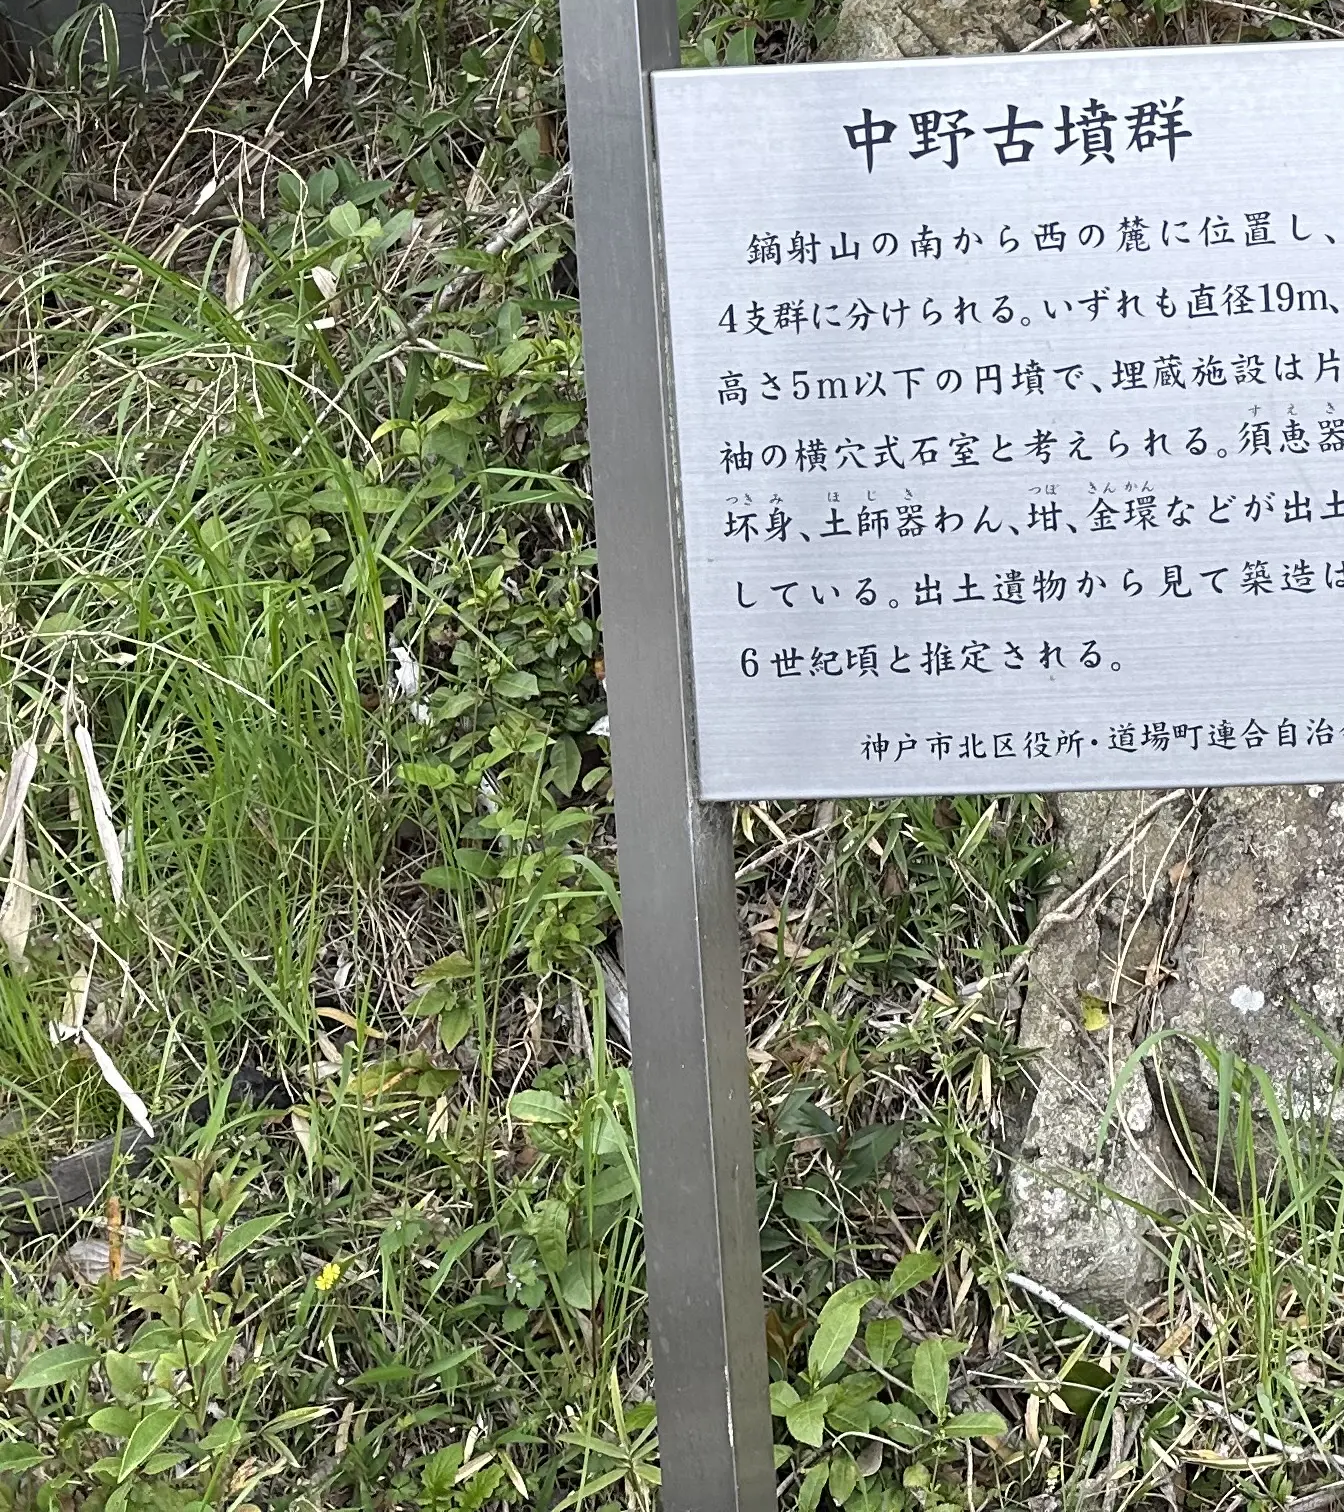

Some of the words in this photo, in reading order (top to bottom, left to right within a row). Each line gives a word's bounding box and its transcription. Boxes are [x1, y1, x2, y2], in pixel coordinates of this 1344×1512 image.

[843, 95, 1193, 175] 中野古墳群
[745, 210, 1336, 266] 鏑射山の南から西の麓に位置し、
[717, 281, 1340, 336] 4支群に分けられる。いずれも直径19m、
[717, 347, 1341, 406] 高さ5m以下の円墳で、埋蔵施設は片
[740, 639, 1121, 679] 6世紀頃と推定される。
